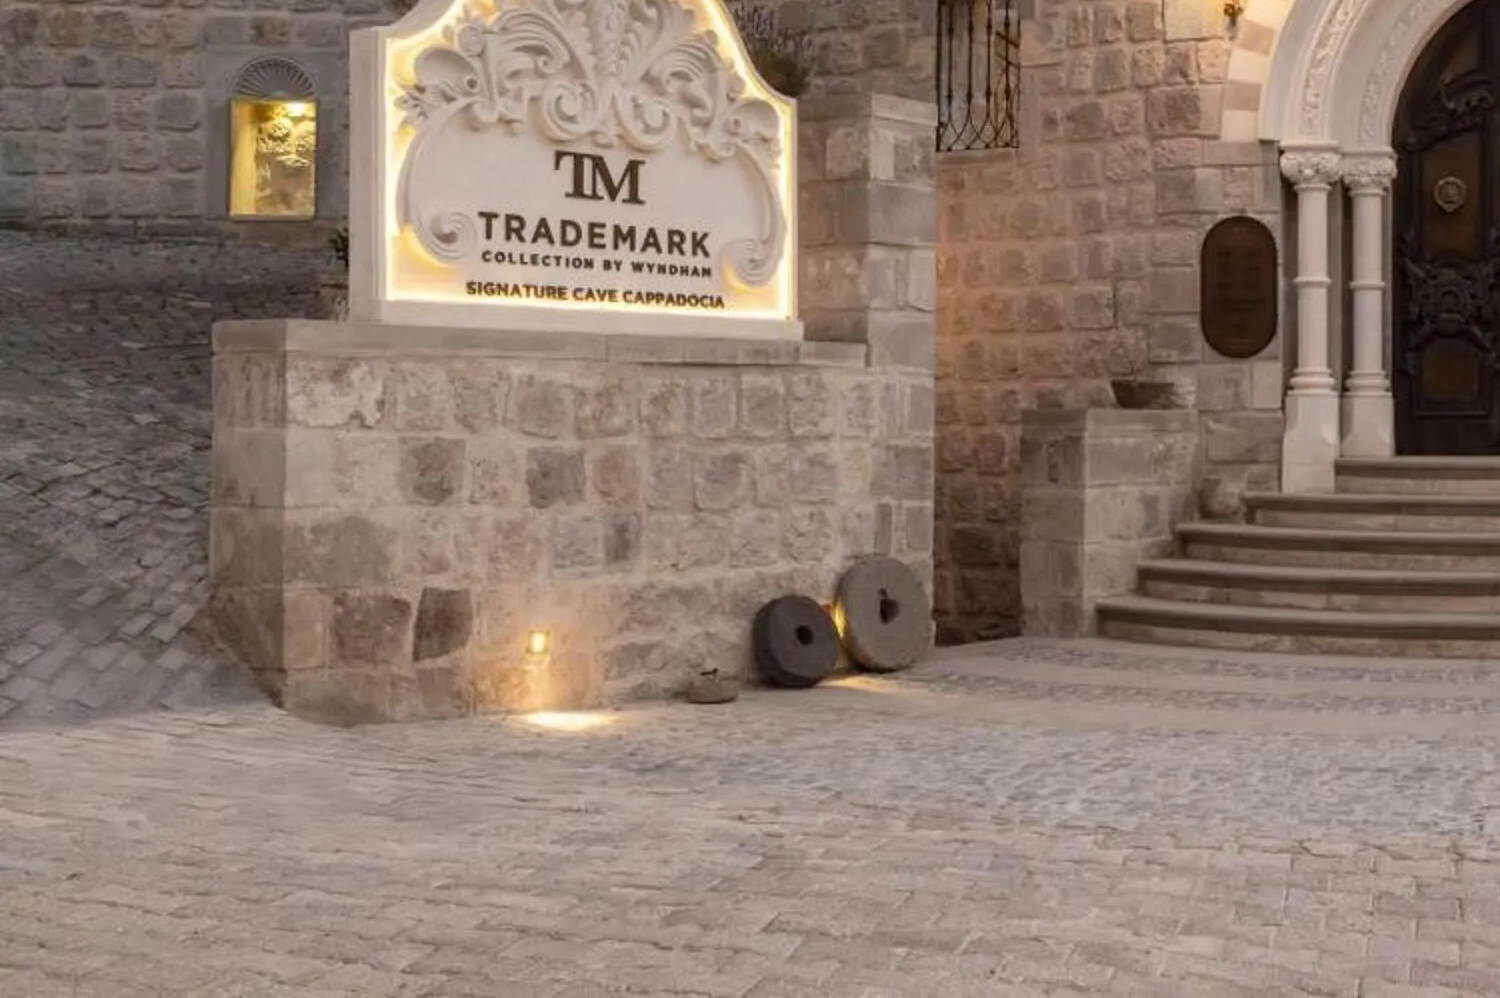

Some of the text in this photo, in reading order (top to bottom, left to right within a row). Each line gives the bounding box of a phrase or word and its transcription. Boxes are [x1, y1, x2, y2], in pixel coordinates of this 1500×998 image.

[554, 150, 646, 206] TM
[478, 210, 711, 258] TRADEMARK
[481, 249, 595, 269] COLLECTION
[602, 259, 623, 272] BY
[466, 281, 725, 309] SIGNATURE CAVE CAPPADOCIA
